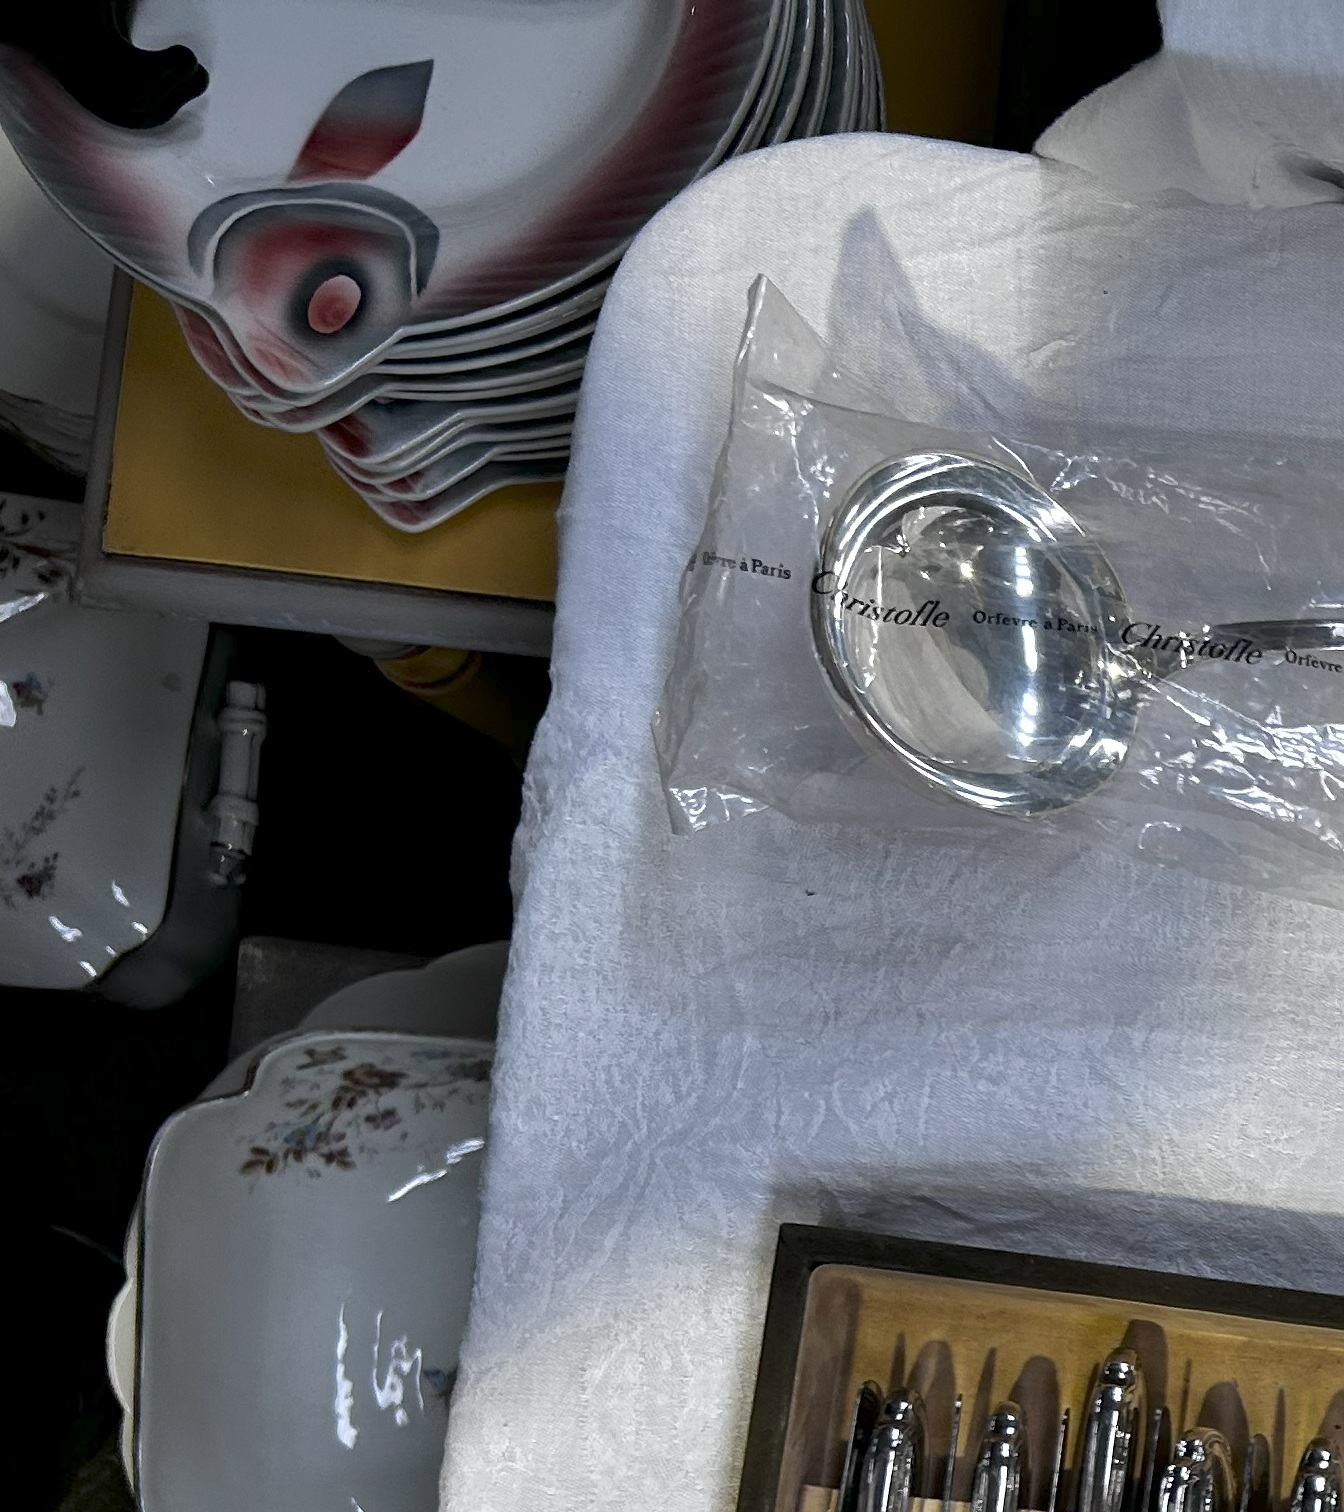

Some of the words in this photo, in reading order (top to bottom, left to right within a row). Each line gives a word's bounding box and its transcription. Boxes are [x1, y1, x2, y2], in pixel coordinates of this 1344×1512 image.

[751, 557, 792, 580] Paris
[1056, 617, 1099, 634] Paris
[1120, 620, 1263, 666] Christofle
[1284, 649, 1343, 674] Orfèvre
